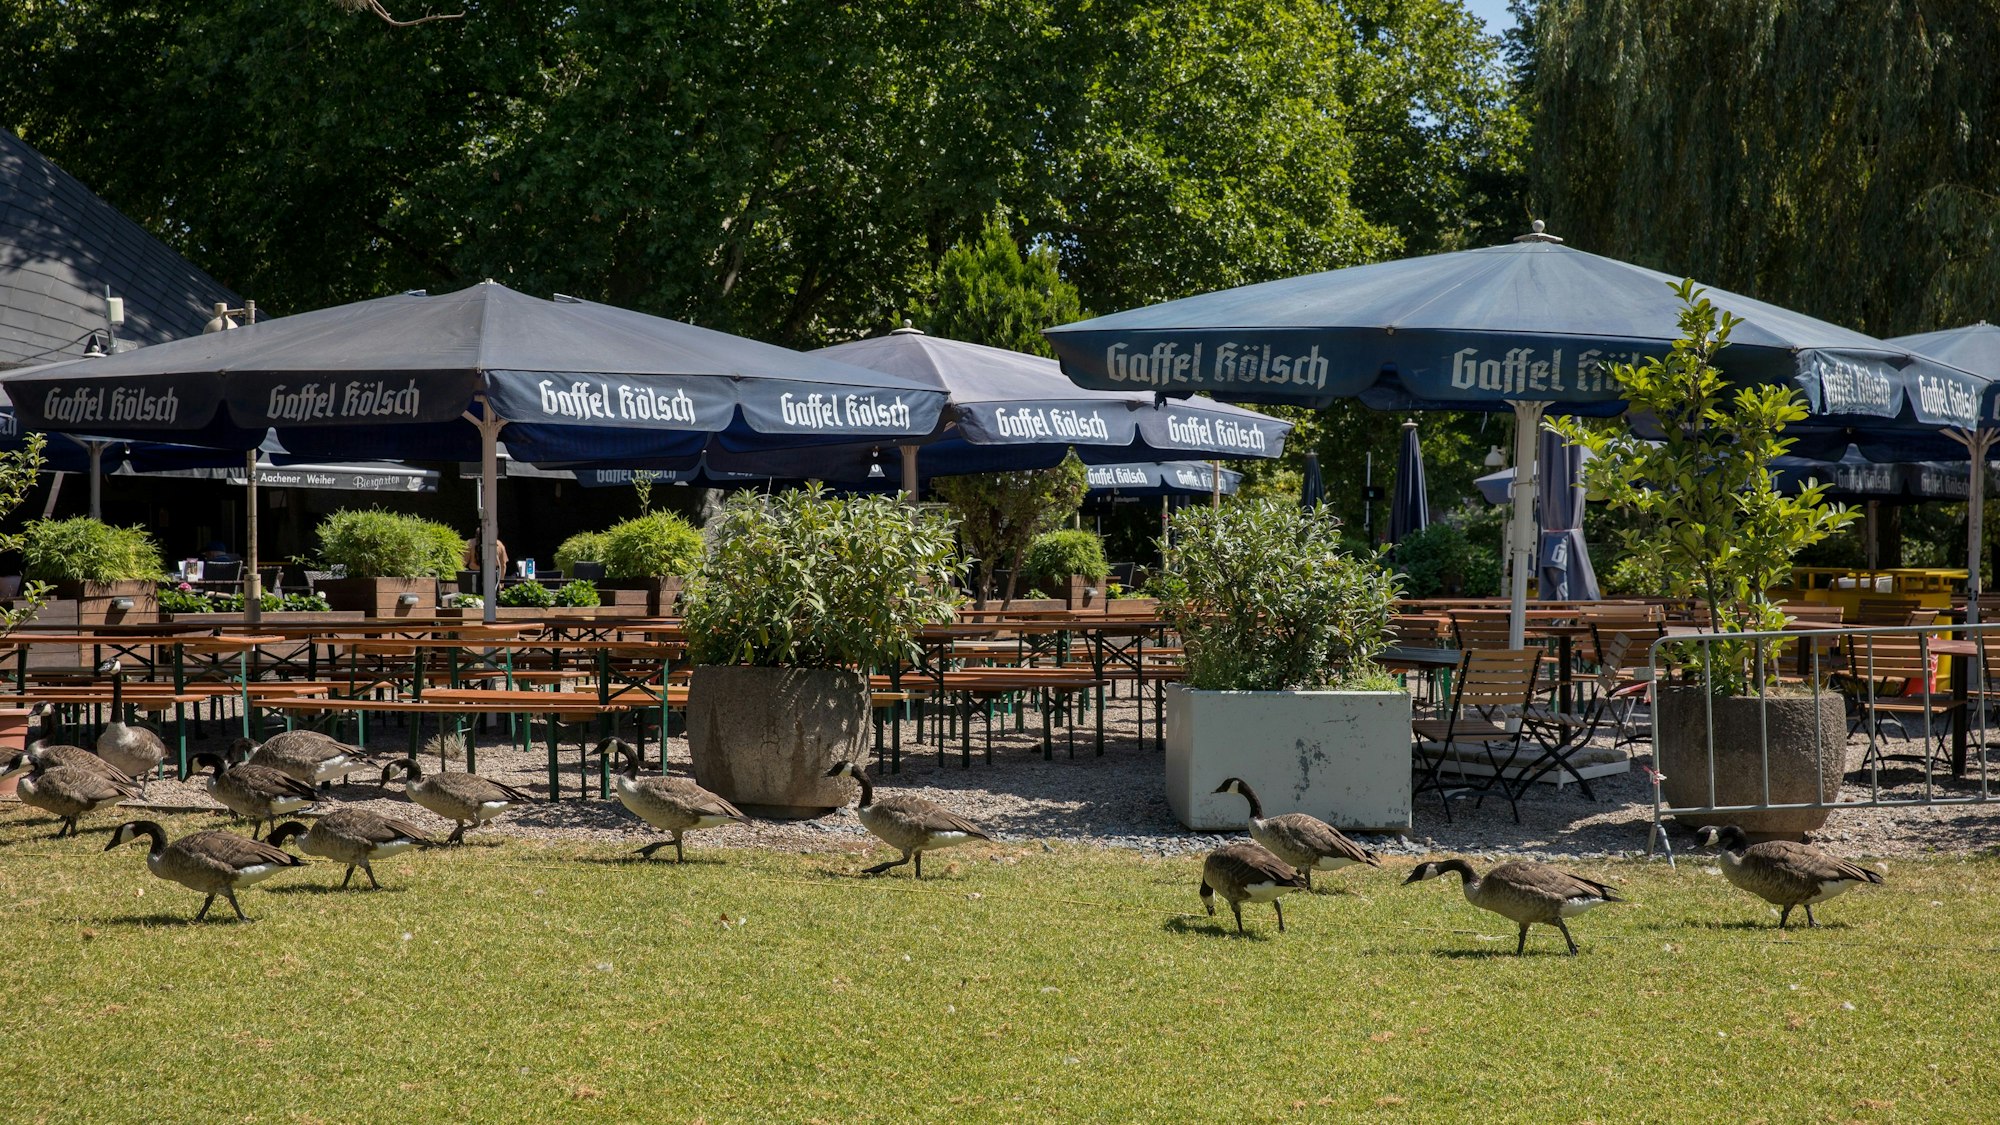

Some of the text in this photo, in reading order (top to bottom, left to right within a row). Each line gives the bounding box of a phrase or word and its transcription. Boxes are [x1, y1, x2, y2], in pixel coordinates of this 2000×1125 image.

[1107, 341, 1329, 390] Gaffel Kölsch
[1450, 347, 1565, 395] Gaffel
[44, 386, 179, 424] Gaffel Kölsch
[267, 378, 420, 421] Gaffel Kölsch
[539, 379, 696, 425] Gaffel Kölsch
[780, 392, 911, 430] Gaffel Kölsch
[1918, 374, 1950, 418] Gaffel
[996, 407, 1108, 441] Gaffel Kölsch
[1168, 414, 1266, 452] Gaffel Kölsch
[260, 472, 336, 485] Aachener Weiher
[353, 476, 400, 490] Biergarten
[1088, 467, 1148, 486] Gaffel Kölsch
